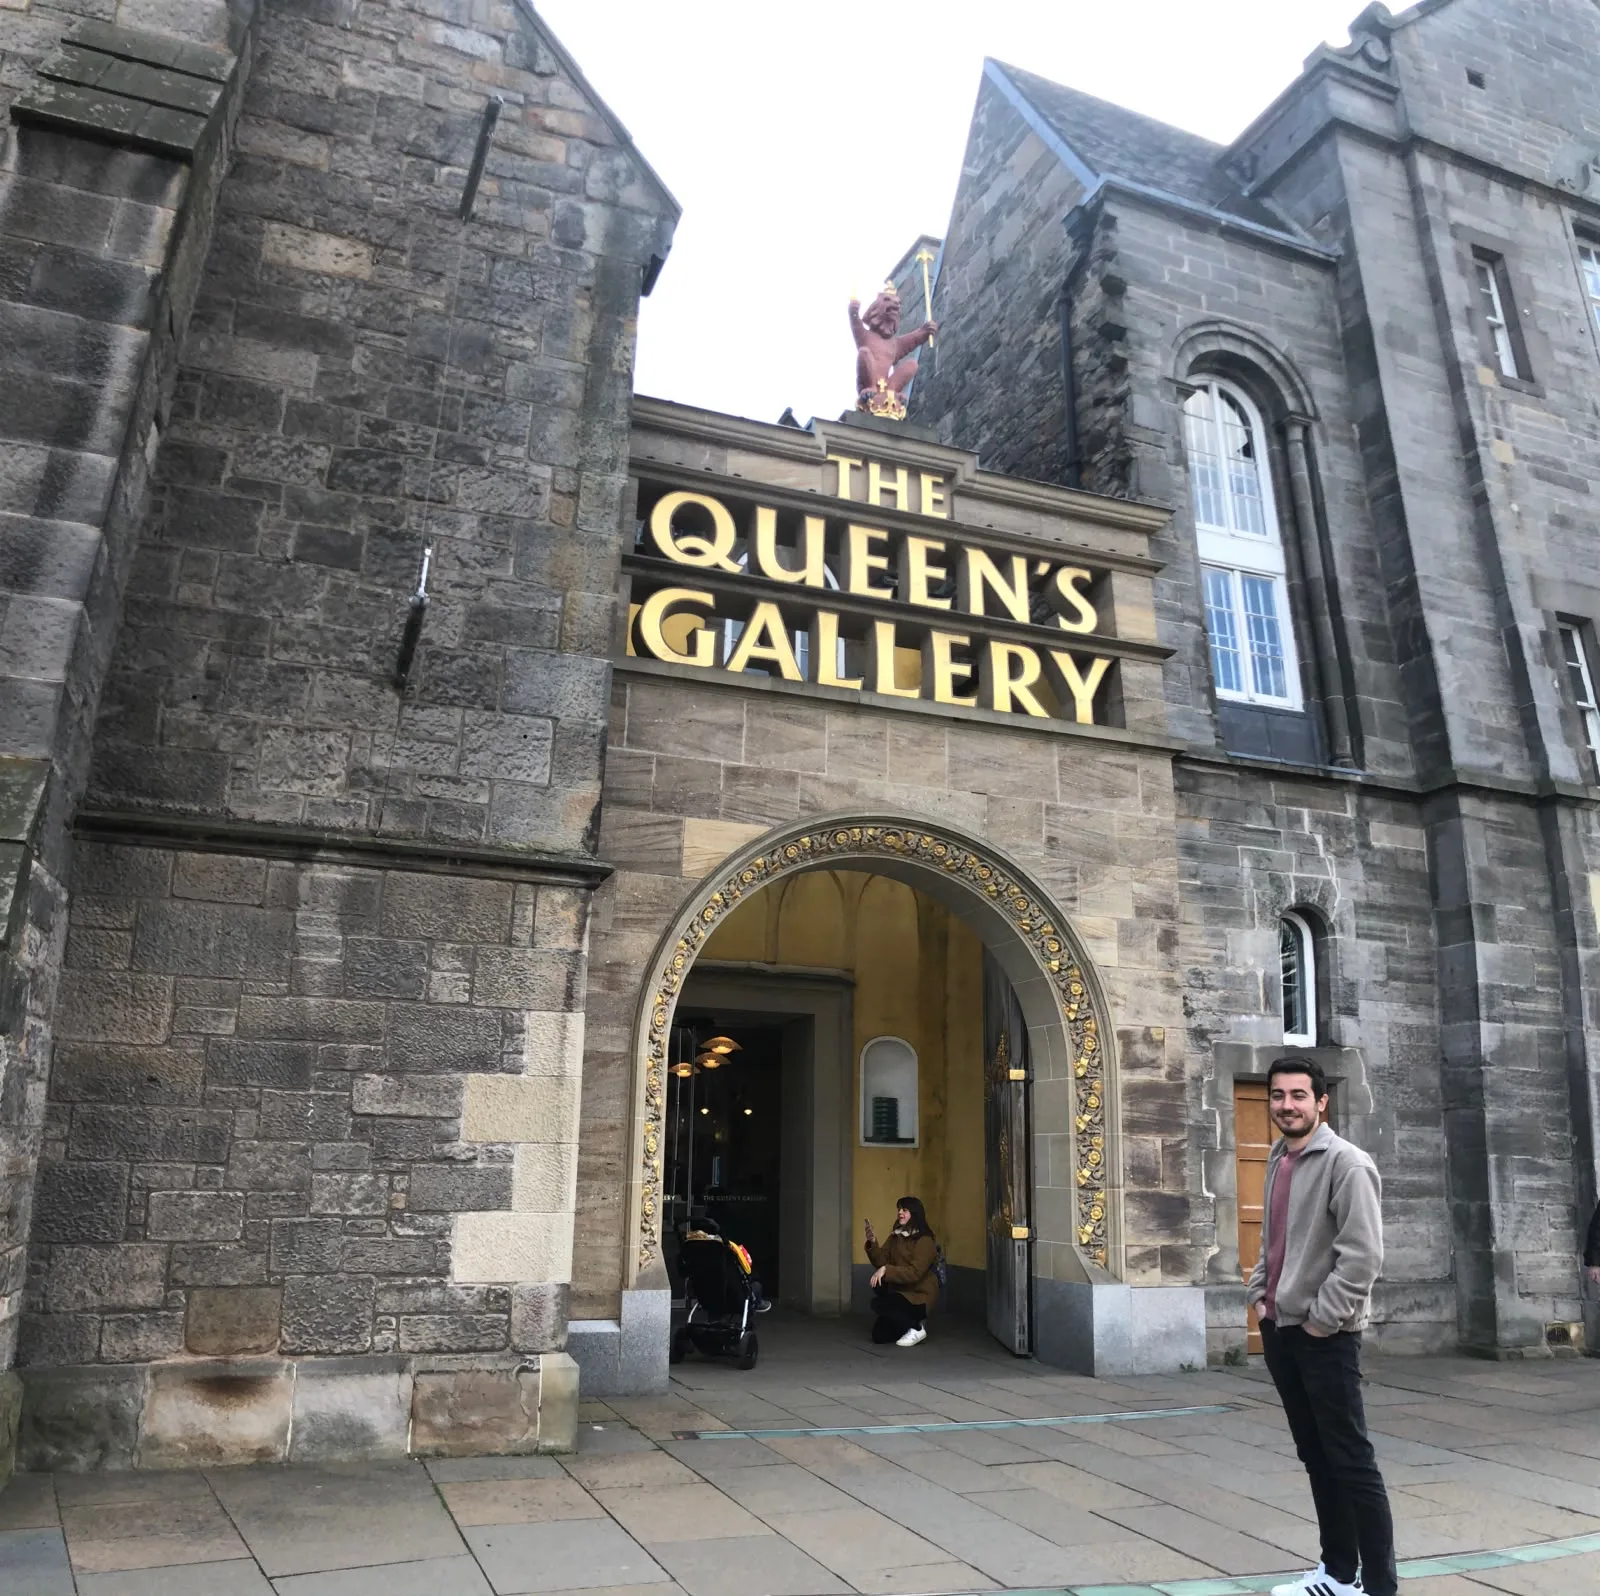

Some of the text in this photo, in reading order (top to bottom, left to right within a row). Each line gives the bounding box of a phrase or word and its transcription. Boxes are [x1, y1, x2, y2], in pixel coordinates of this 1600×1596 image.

[826, 453, 951, 519] THE
[649, 490, 1099, 634] QUEEN'S
[639, 587, 1112, 725] GALLERY
